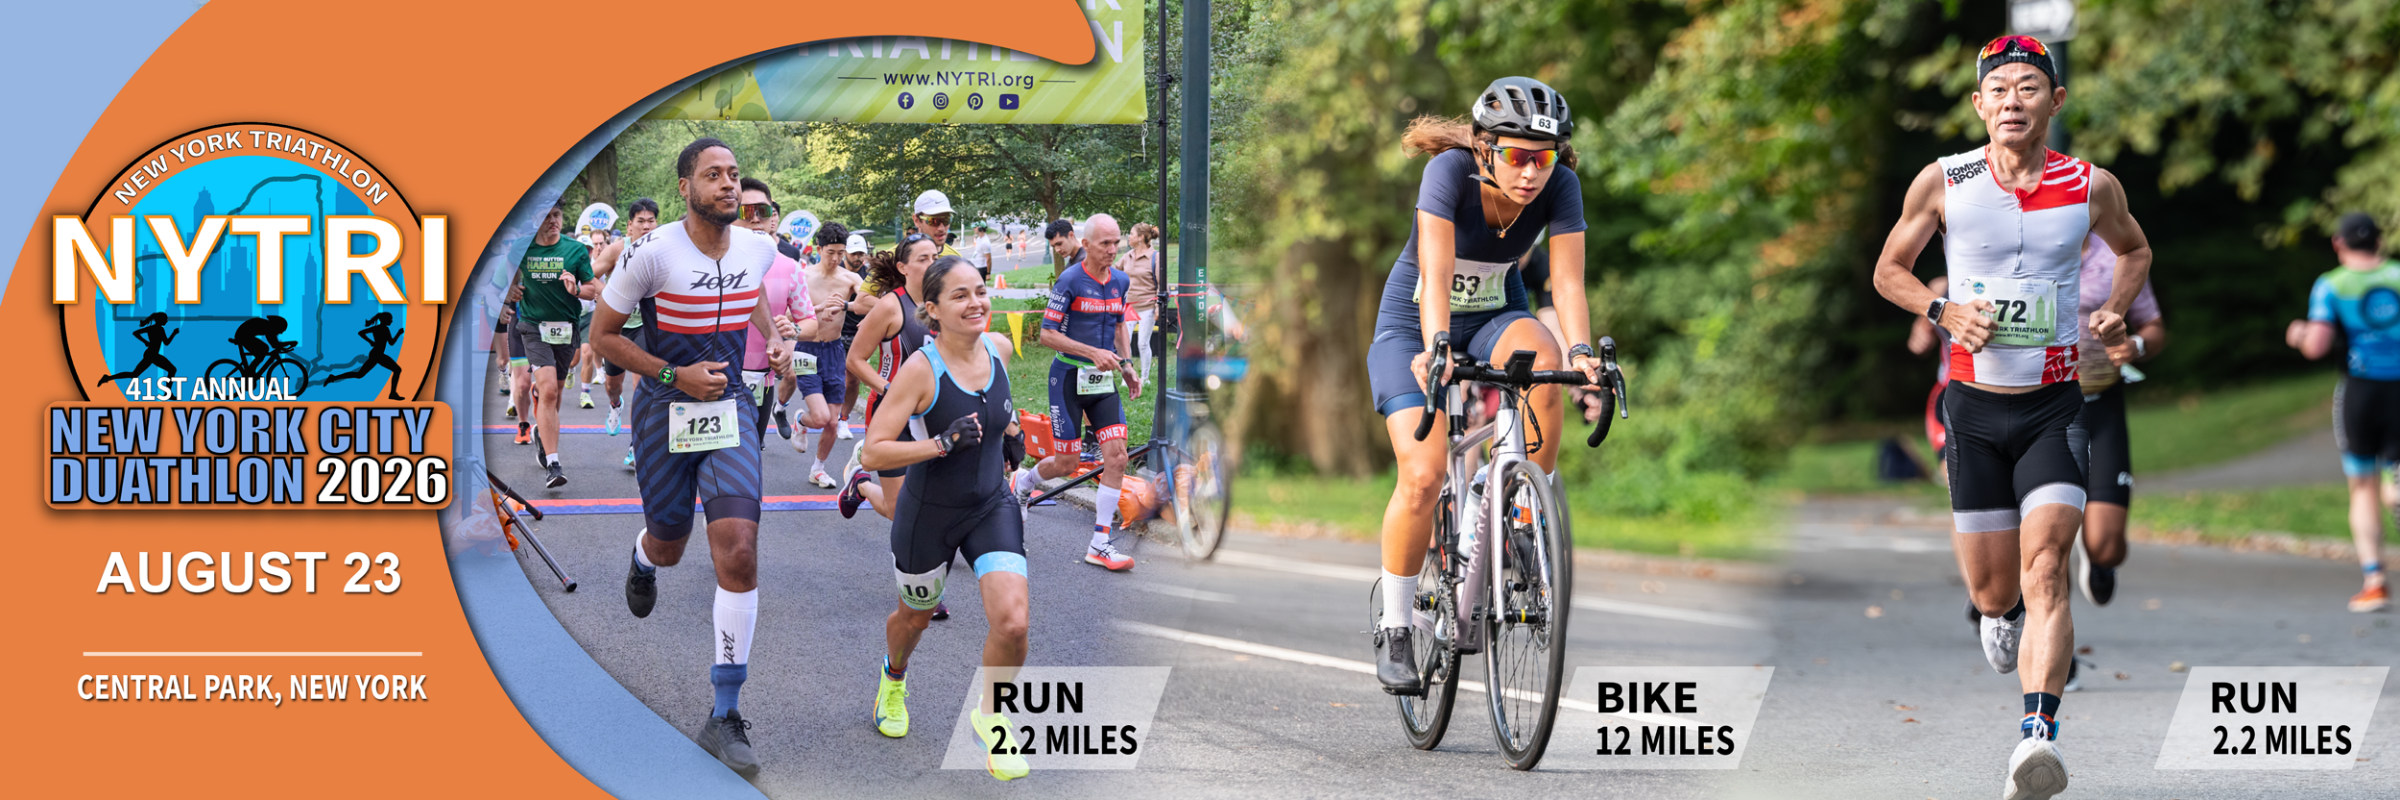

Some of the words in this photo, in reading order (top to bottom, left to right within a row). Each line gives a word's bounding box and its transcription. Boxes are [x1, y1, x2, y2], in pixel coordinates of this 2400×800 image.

[884, 71, 1034, 90] www.NYTRI.org
[1538, 118, 1551, 129] 63
[526, 261, 564, 270] HARLEM
[1451, 273, 1481, 296] 63
[1995, 299, 2027, 323] 72
[550, 327, 562, 336] 92
[2010, 326, 2049, 334] TRIATHLON
[794, 358, 809, 368] 115
[1088, 374, 1103, 384] 99
[687, 416, 721, 435] 123
[903, 584, 929, 599] 10
